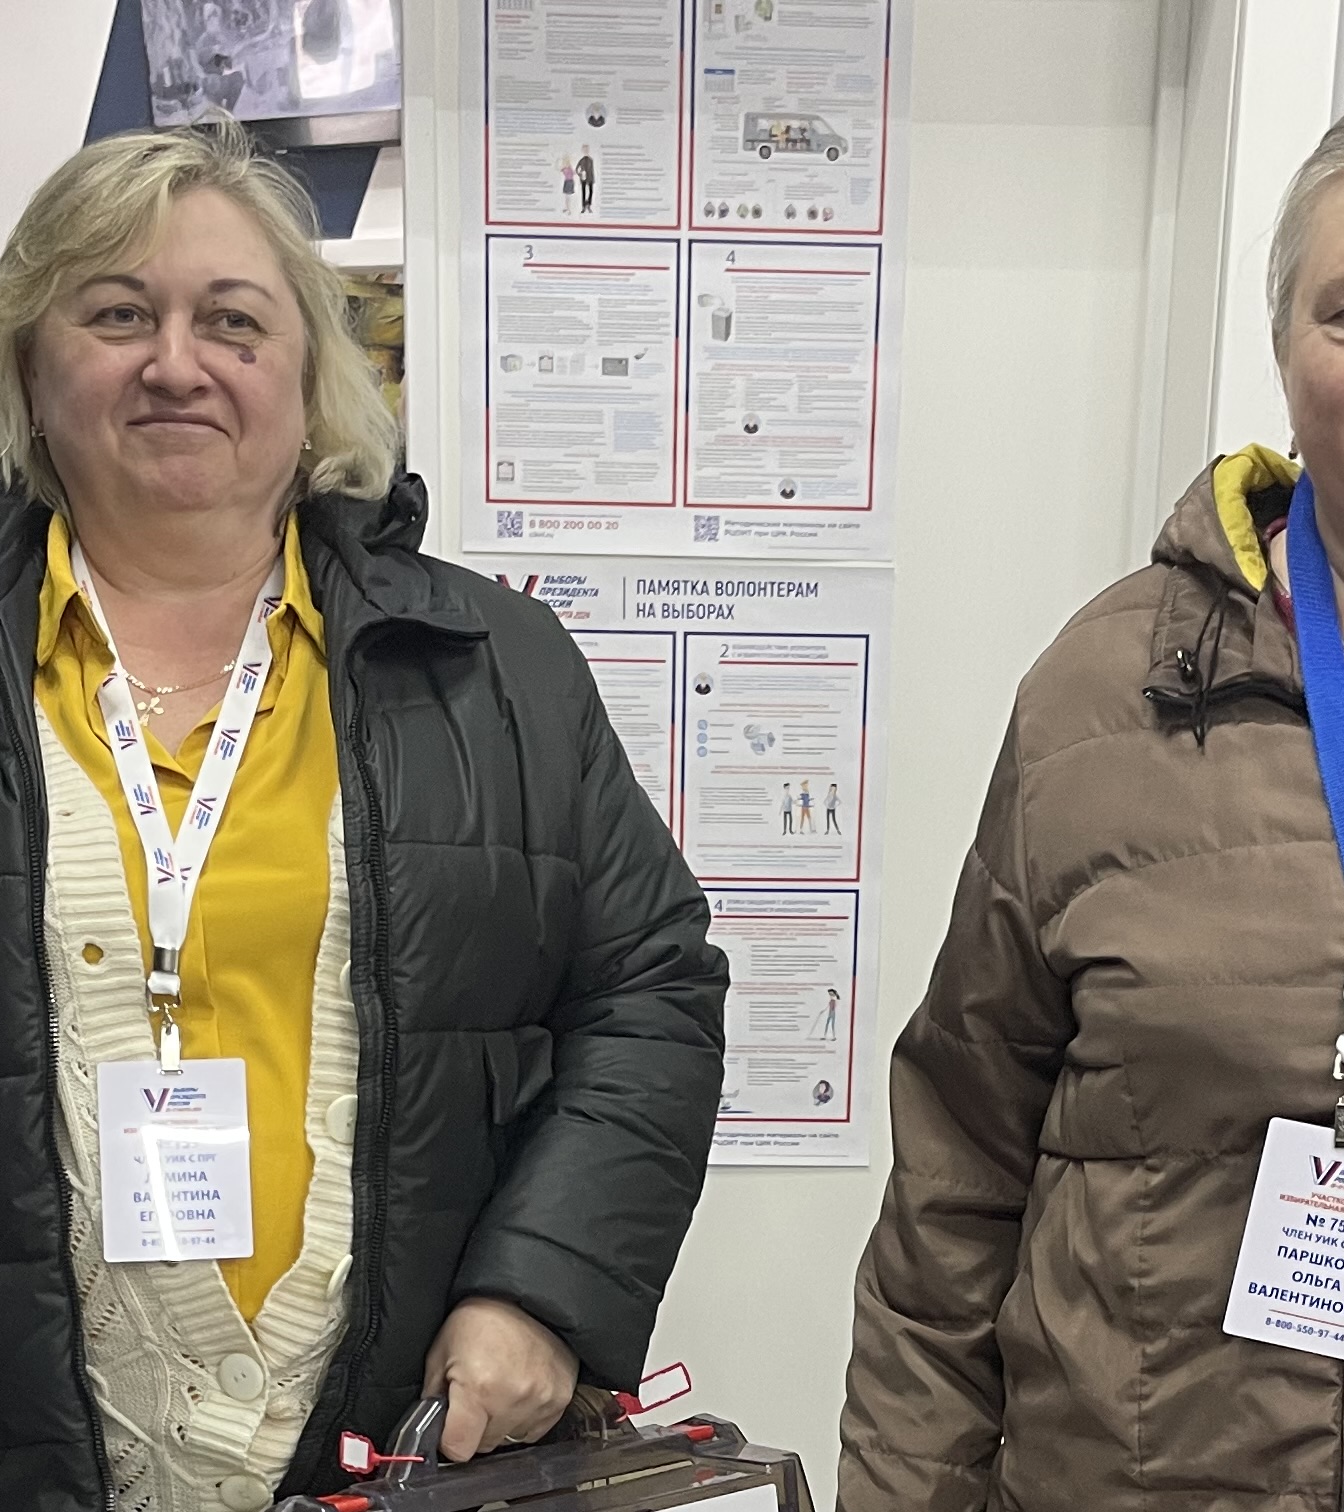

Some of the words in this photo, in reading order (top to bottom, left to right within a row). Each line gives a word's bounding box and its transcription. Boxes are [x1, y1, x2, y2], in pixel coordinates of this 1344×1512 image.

[523, 244, 534, 261] 3
[726, 250, 737, 265] 4
[562, 520, 584, 530] 200
[587, 521, 602, 530] 00
[604, 521, 619, 530] 20
[543, 575, 587, 585] ВЫБОРЫ
[538, 587, 599, 598] ПРЕЗИДЕНТА
[636, 579, 710, 596] ПАМЯТКА
[715, 580, 819, 598] ВОЛОНТЕРАМ
[636, 602, 656, 618] НА
[661, 603, 735, 620] ВЫБОРАХ
[719, 643, 730, 658] 2
[713, 899, 723, 912] 4
[133, 1189, 221, 1203] ВАНТИНА
[140, 1209, 216, 1222] ЕГОВНА
[1305, 1212, 1326, 1228] №
[1282, 1226, 1313, 1242] ЧЛЕН
[1315, 1234, 1339, 1248] УИК
[1291, 1270, 1341, 1291] ОЛЬГА
